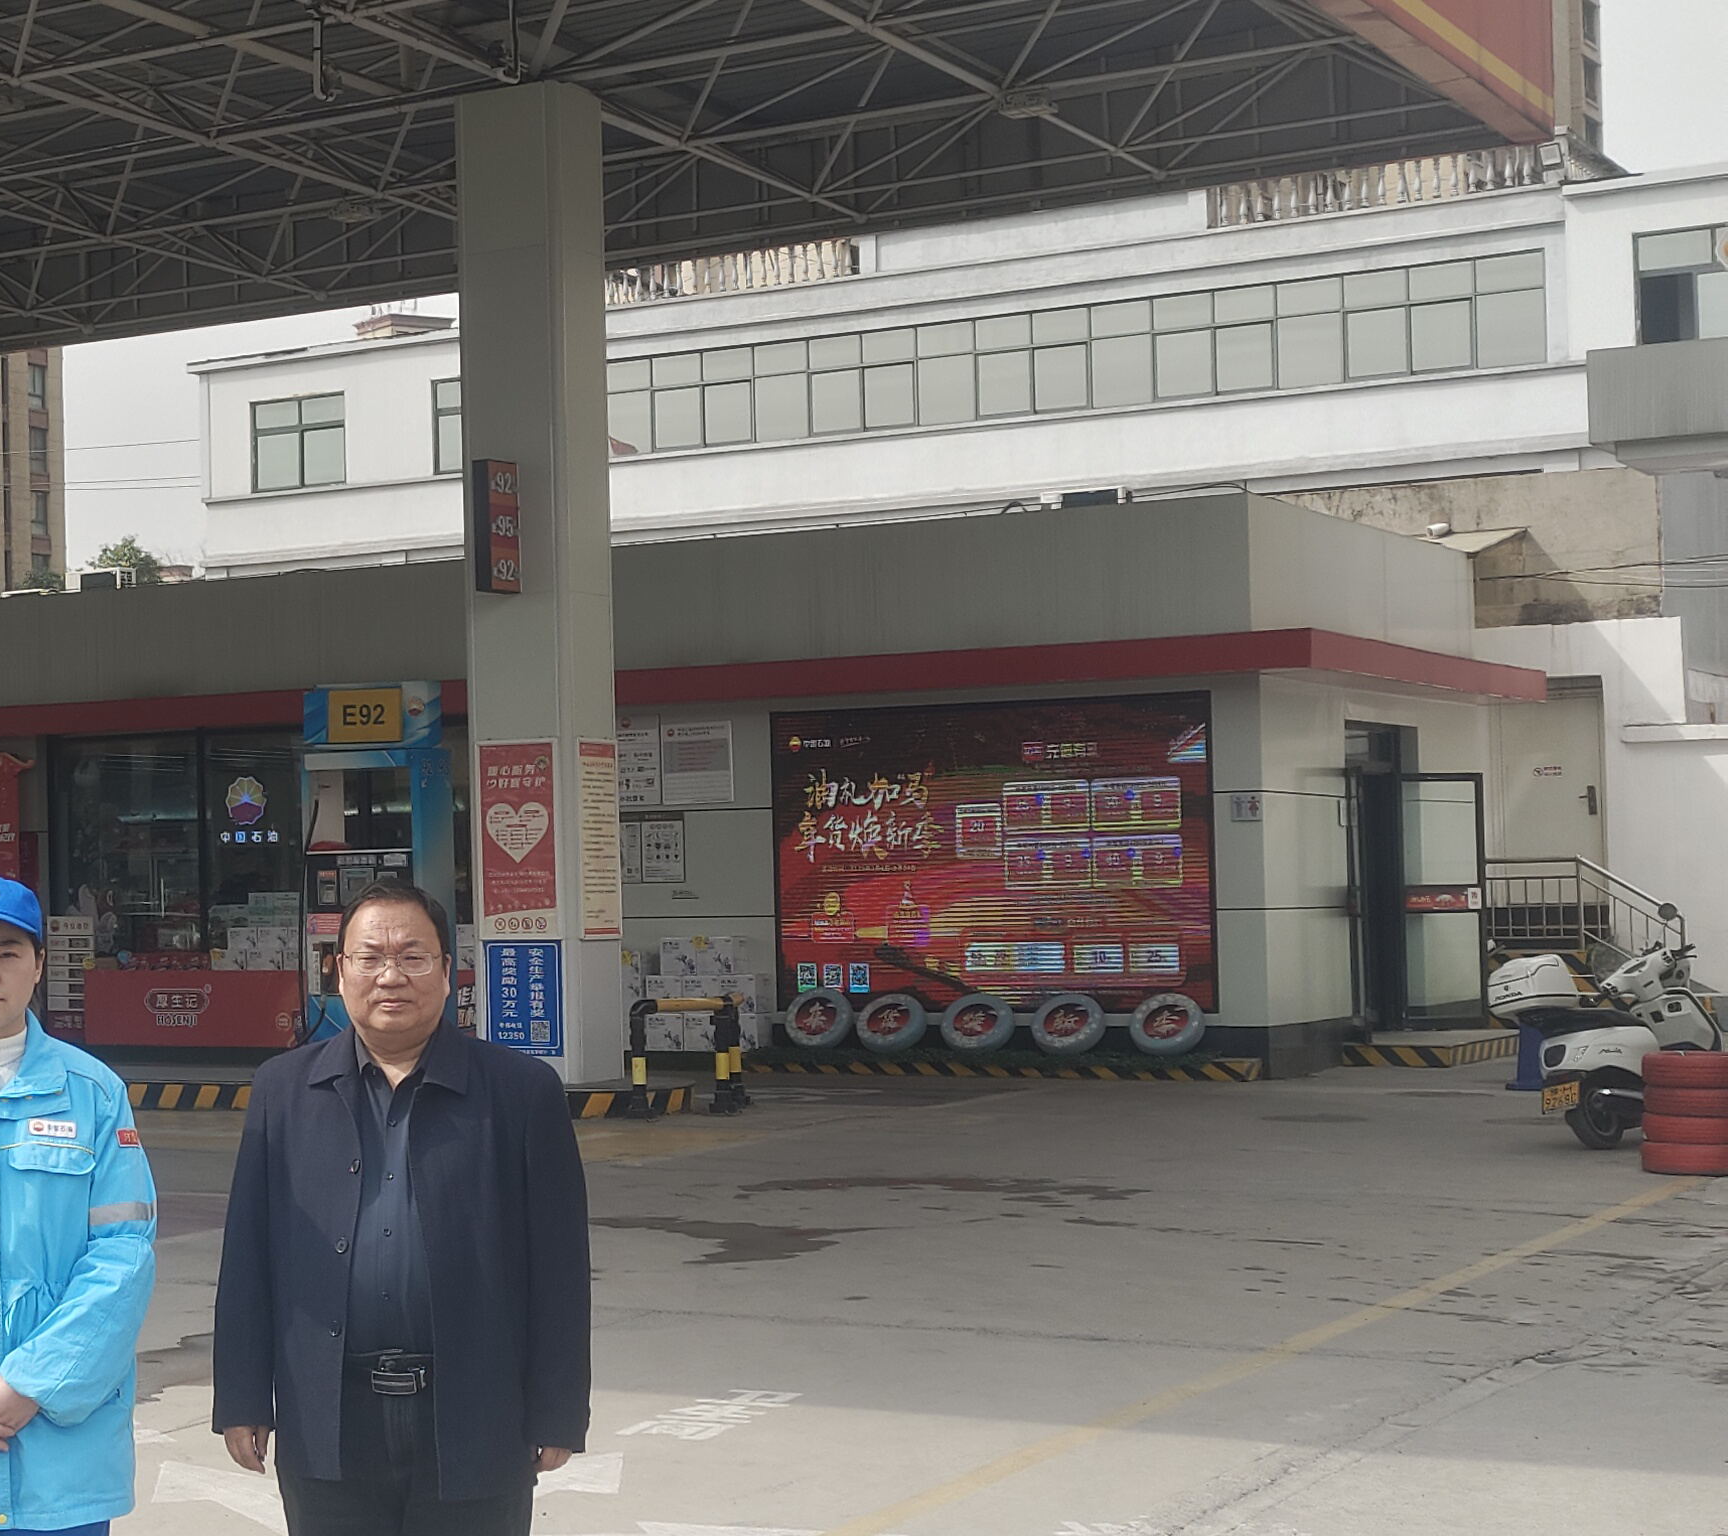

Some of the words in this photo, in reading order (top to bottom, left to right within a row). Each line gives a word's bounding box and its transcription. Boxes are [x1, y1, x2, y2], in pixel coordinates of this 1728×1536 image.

[342, 704, 385, 726] E92
[221, 830, 278, 843] 中国石油
[497, 1032, 525, 1040] 12350
